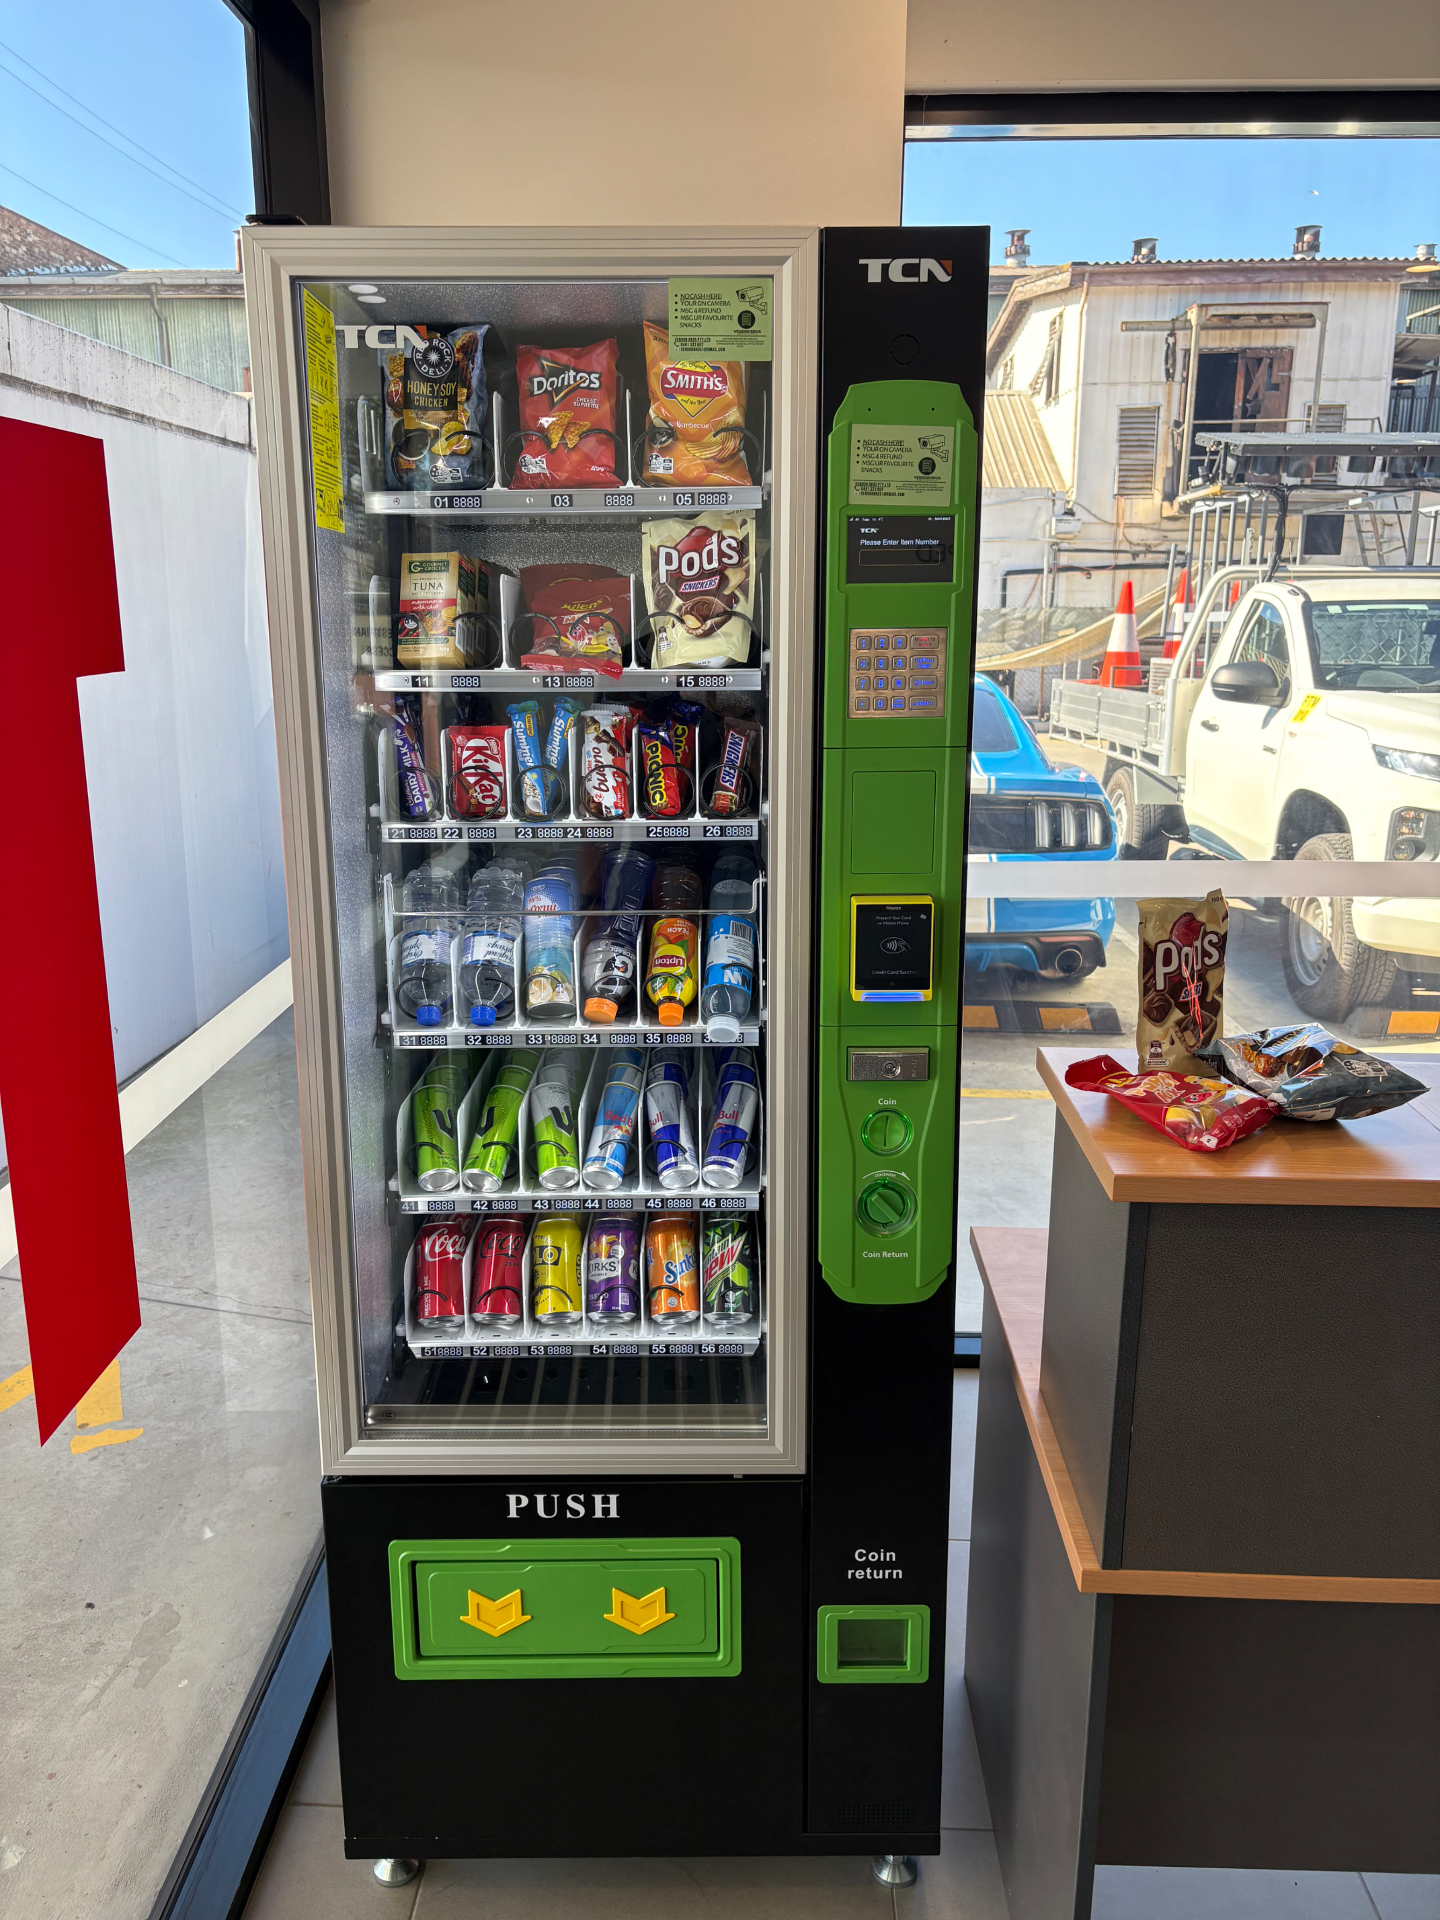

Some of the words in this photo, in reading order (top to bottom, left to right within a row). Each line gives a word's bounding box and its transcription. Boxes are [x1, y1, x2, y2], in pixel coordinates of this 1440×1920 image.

[859, 258, 953, 283] TCN
[335, 324, 429, 349] TCN
[432, 338, 452, 363] ROCK
[420, 364, 445, 376] DELI
[534, 369, 600, 395] Doritos
[664, 370, 723, 390] SMITH'S
[407, 380, 438, 396] HONEY
[440, 382, 457, 396] SOY
[414, 396, 448, 408] CHICKEN
[573, 401, 599, 409] SUPREME
[676, 421, 710, 430] Barbecue
[434, 497, 448, 508] 01
[554, 496, 570, 507] 03
[676, 494, 692, 505] 05
[658, 532, 740, 584] Pods
[412, 582, 444, 591] TUNA
[681, 578, 718, 591] SNICKERS
[880, 638, 884, 648] 2
[897, 638, 902, 647] 3
[860, 660, 866, 668] 4
[878, 660, 883, 668] 5
[896, 659, 902, 668] 6
[415, 677, 429, 687] 11
[545, 677, 560, 687] 13
[679, 676, 694, 686] 15
[860, 680, 866, 688] 7
[878, 680, 883, 688] 8
[878, 700, 883, 708] 0
[525, 714, 534, 736] Europe
[513, 720, 534, 766] Summer
[550, 716, 565, 768] Summer
[400, 744, 412, 768] MILK
[720, 732, 745, 788] SNICKERS
[593, 747, 609, 792] bueno
[646, 740, 666, 806] PICNIC
[407, 772, 422, 804] DAIRY
[391, 829, 405, 838] 21
[444, 829, 459, 838] 22
[518, 828, 532, 838] 23
[567, 828, 582, 837] 24
[649, 827, 663, 837] 25
[706, 827, 720, 836] 26
[667, 926, 690, 936] PEACH
[655, 956, 683, 967] Lipton
[1155, 926, 1220, 990] Pods
[402, 1037, 416, 1045] 31
[467, 1036, 481, 1045] 32
[528, 1035, 543, 1044] 33
[583, 1034, 597, 1044] 34
[646, 1034, 660, 1044] 35
[604, 1110, 626, 1123] Red
[718, 1110, 739, 1121] Bull
[402, 1202, 415, 1210] 41
[473, 1201, 488, 1209] 42
[534, 1200, 549, 1209] 43
[585, 1200, 600, 1209] 44
[647, 1199, 662, 1208] 45
[701, 1199, 716, 1207] 46
[424, 1228, 467, 1262] Coca
[480, 1226, 524, 1259] Coca
[473, 1347, 487, 1355] 52
[531, 1346, 544, 1355] 53
[592, 1346, 607, 1354] 54
[652, 1345, 666, 1354] 55
[701, 1344, 715, 1353] 56
[506, 1494, 620, 1518] PUSH
[854, 1549, 896, 1562] Coin
[847, 1567, 903, 1579] return
